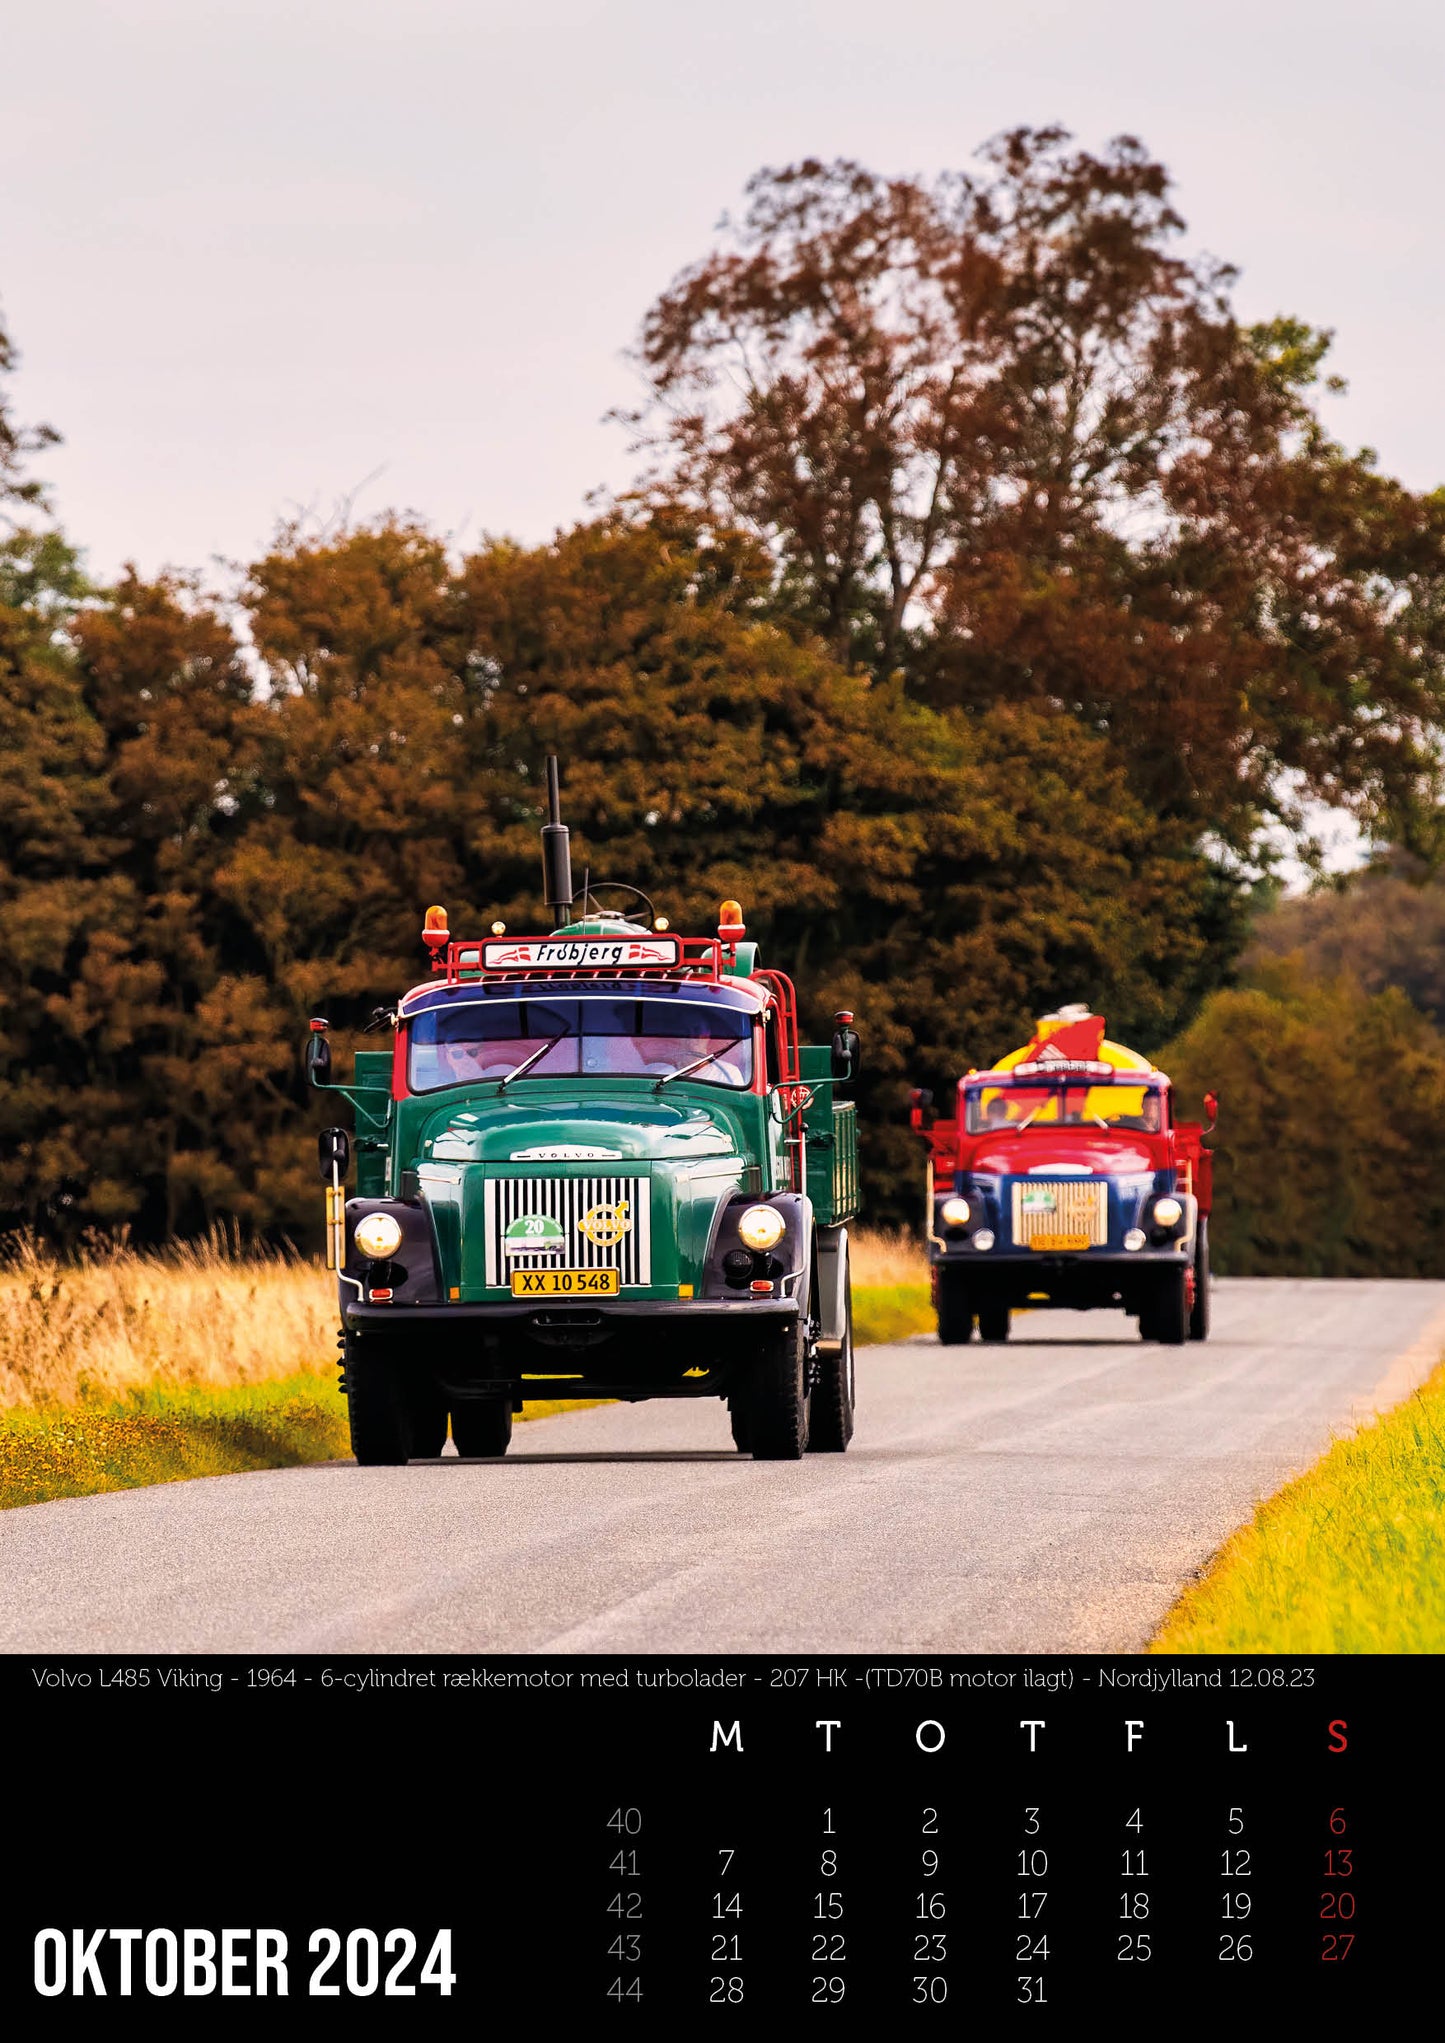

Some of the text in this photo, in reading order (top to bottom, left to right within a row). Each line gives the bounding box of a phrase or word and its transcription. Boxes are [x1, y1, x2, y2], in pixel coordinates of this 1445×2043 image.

[524, 1219, 545, 1235] 20
[582, 1219, 632, 1231] VOLVO
[522, 1273, 611, 1291] XX 10 548
